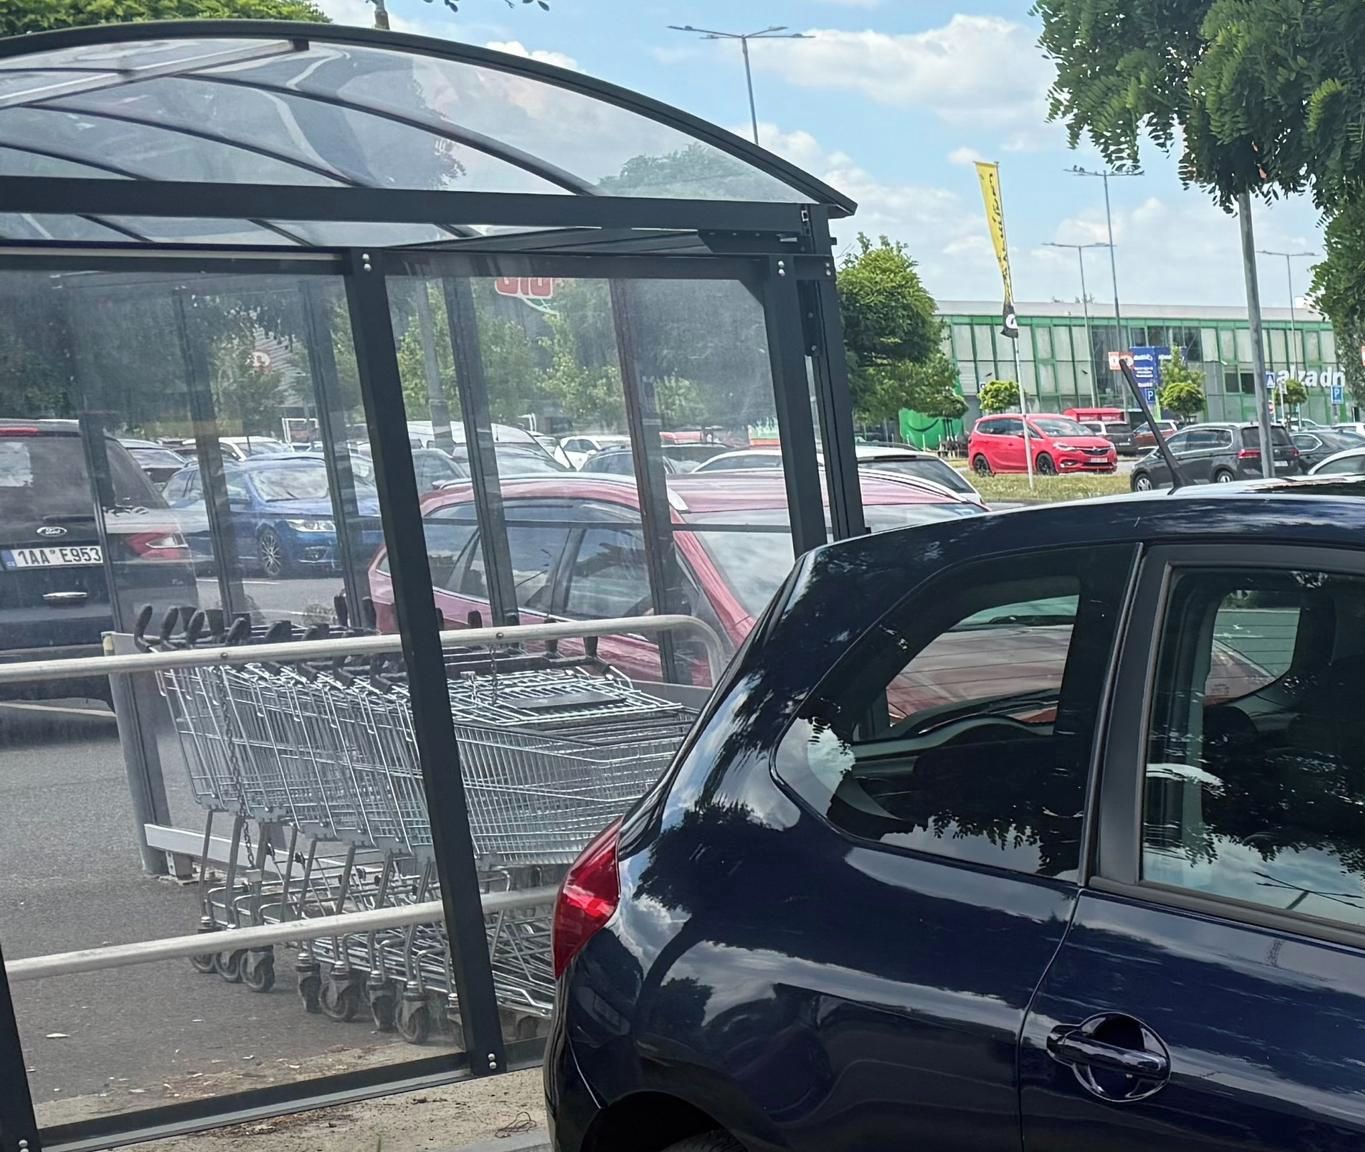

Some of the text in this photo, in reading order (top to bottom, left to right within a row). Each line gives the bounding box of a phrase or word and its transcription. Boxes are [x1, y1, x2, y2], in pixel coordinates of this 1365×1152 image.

[1147, 390, 1154, 400] P
[17, 547, 101, 566] 1AA E953
